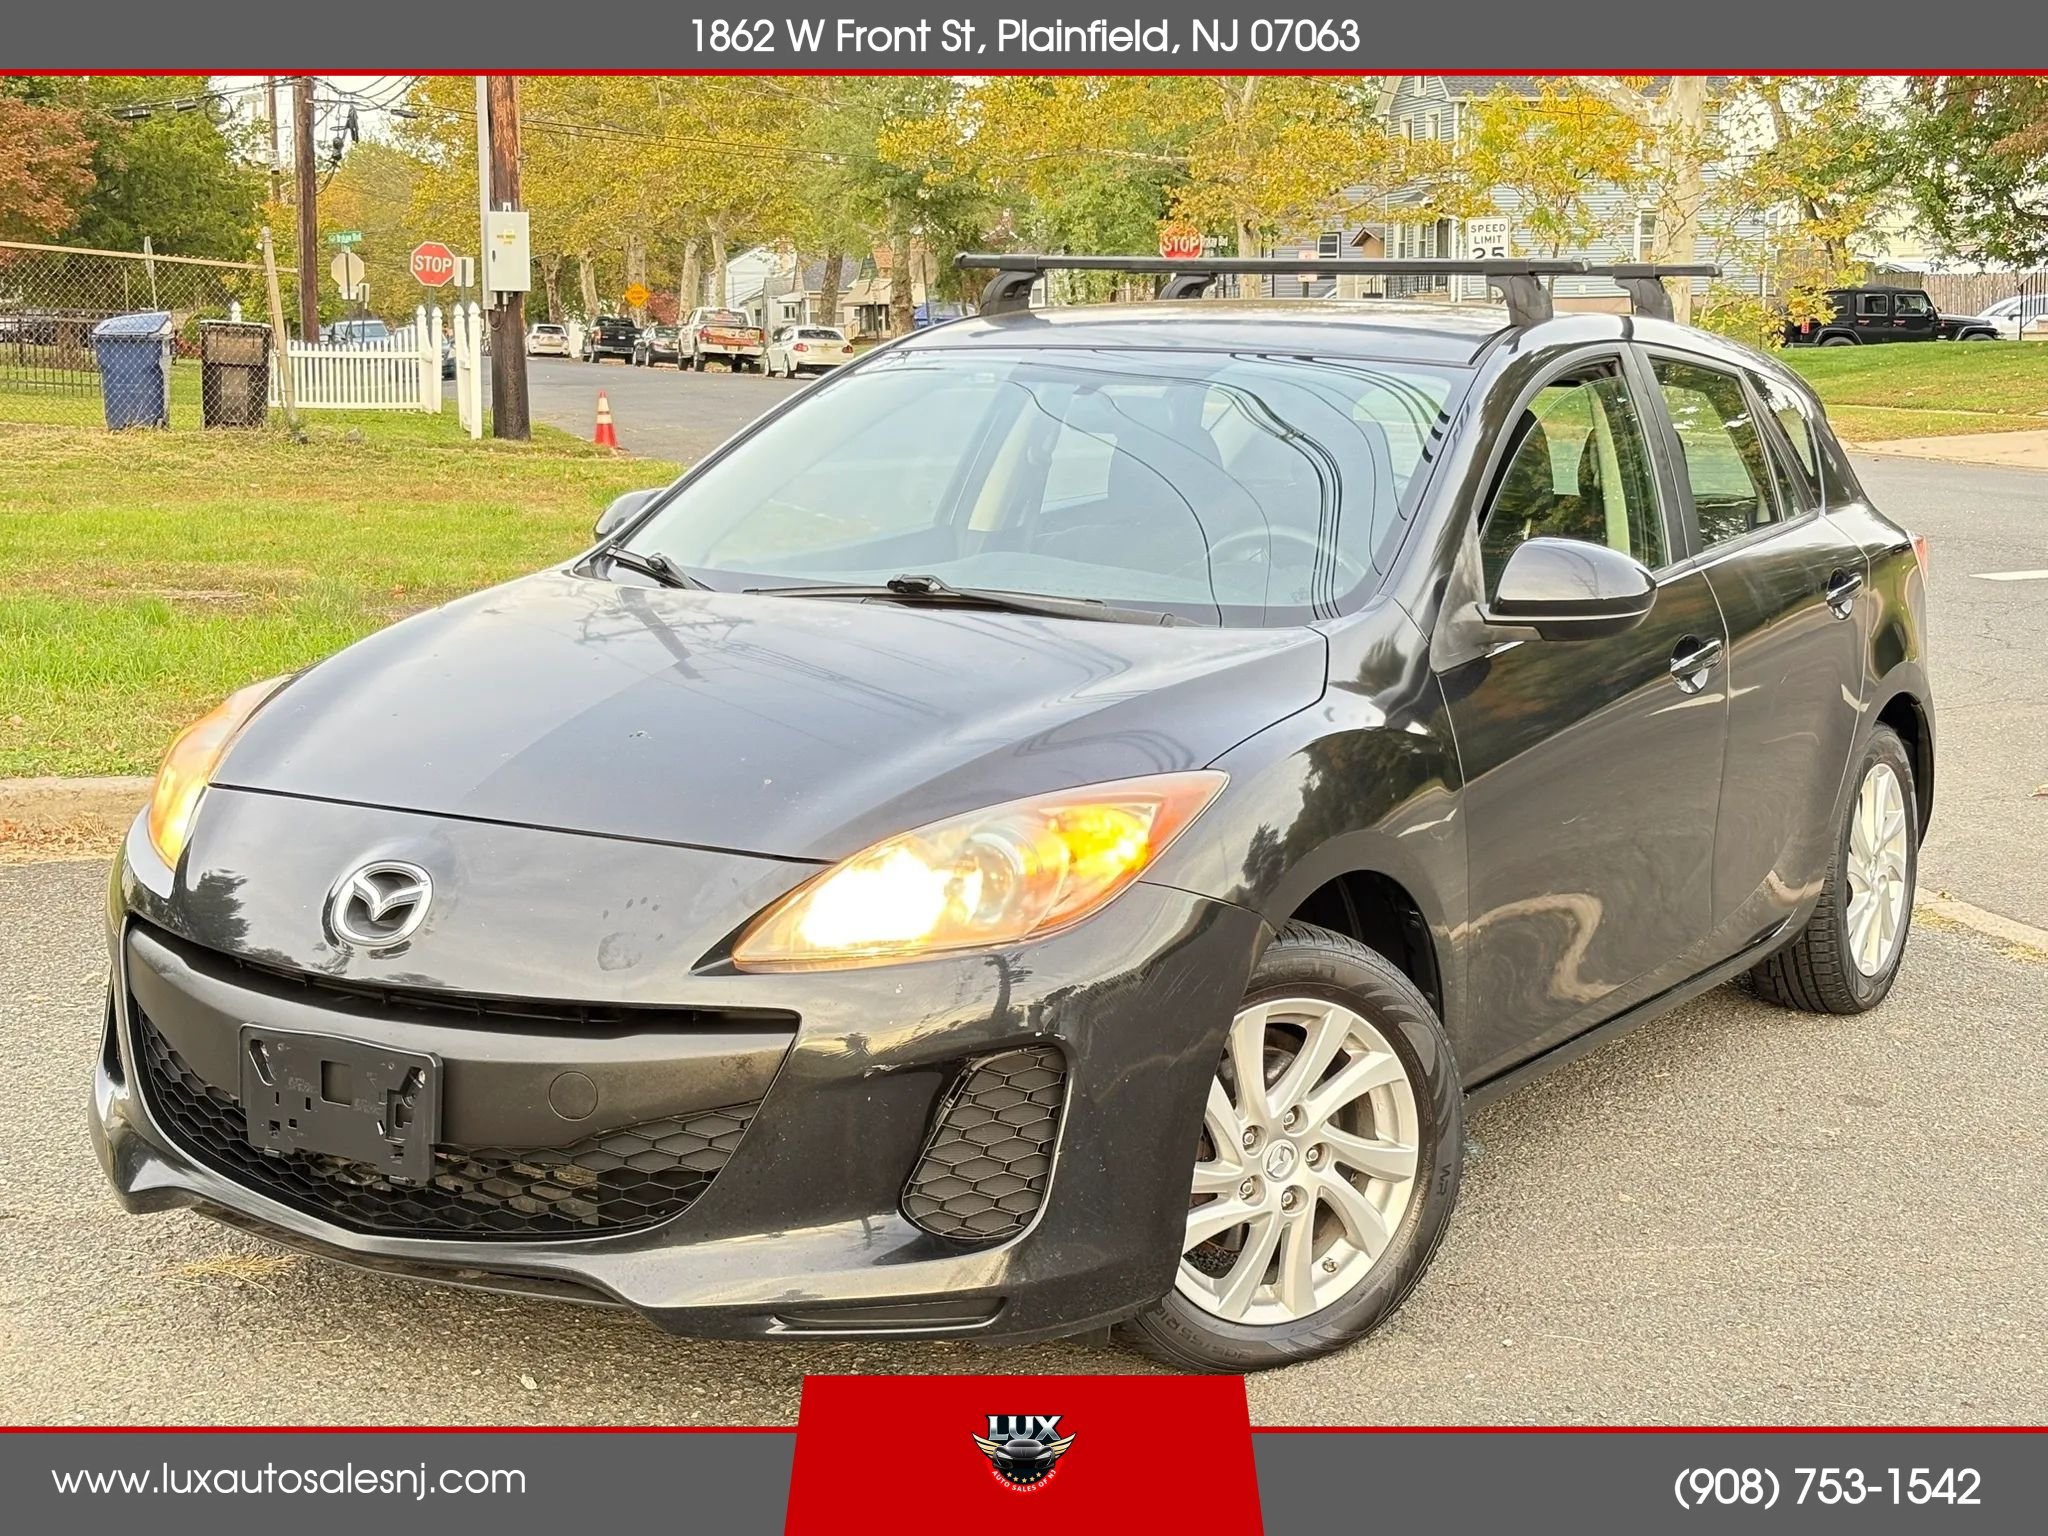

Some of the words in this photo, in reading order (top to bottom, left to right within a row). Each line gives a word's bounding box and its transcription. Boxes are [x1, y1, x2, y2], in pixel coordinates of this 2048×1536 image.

[1470, 223, 1506, 233] SPEED
[1163, 235, 1200, 253] STOP
[1474, 235, 1502, 245] LIMIT
[1472, 246, 1505, 260] 25
[414, 255, 453, 274] STOP
[1436, 1162, 1452, 1196] WR
